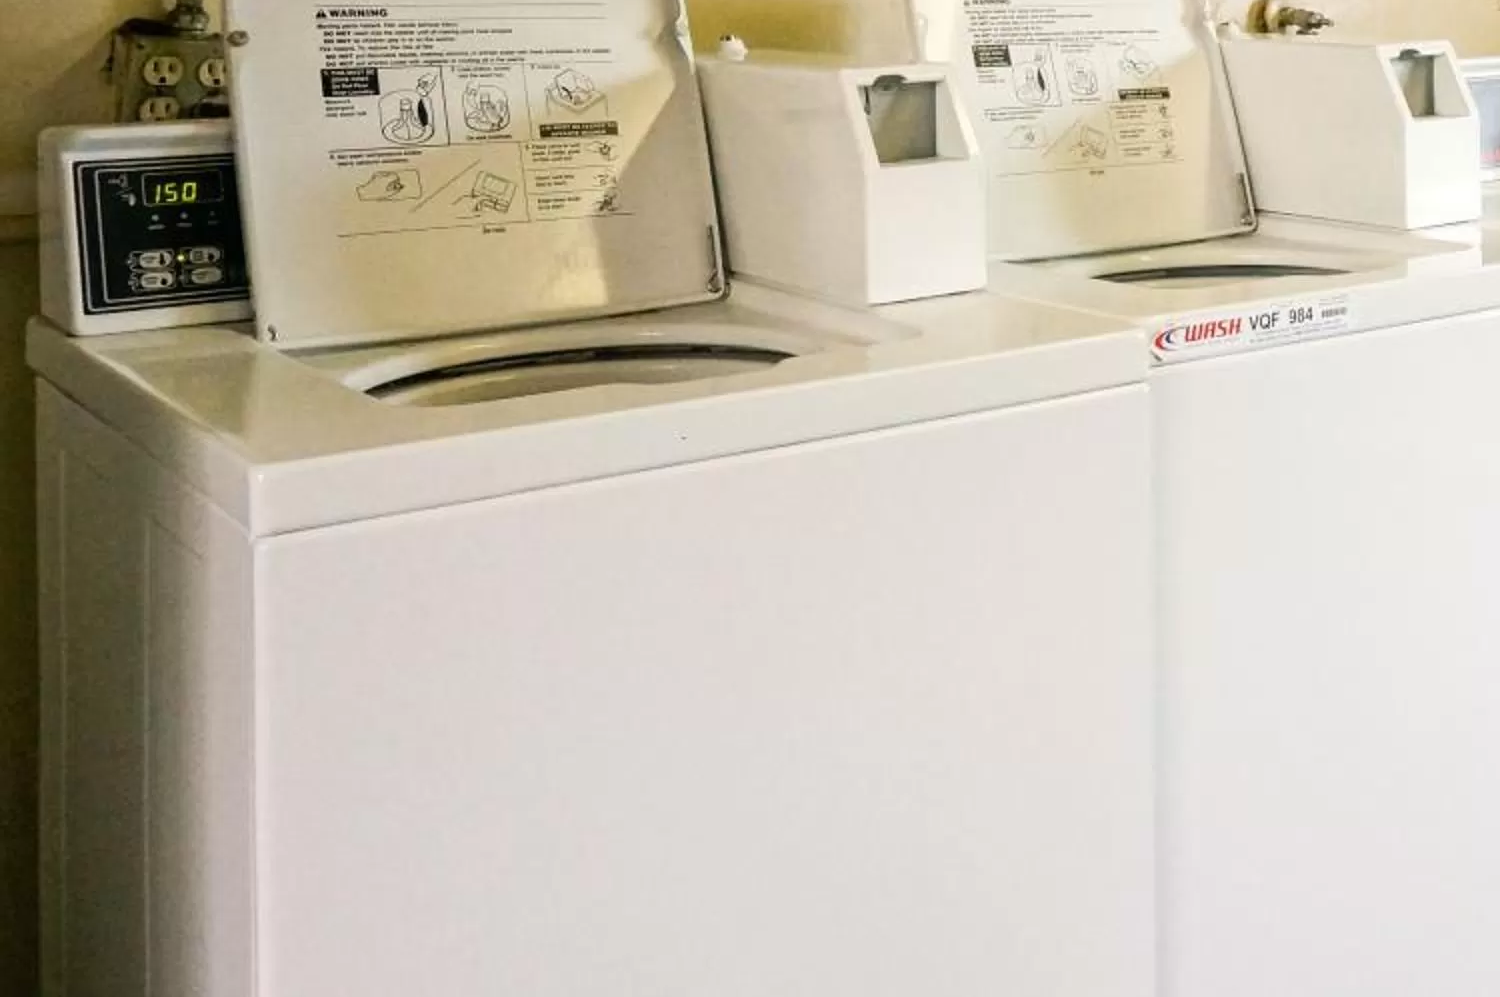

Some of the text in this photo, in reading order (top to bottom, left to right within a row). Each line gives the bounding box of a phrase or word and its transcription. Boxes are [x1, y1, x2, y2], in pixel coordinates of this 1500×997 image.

[329, 8, 388, 18] WARNING
[155, 181, 198, 203] 150
[1183, 317, 1243, 343] WASH
[1248, 311, 1280, 331] VQF
[1289, 307, 1314, 324] 984
